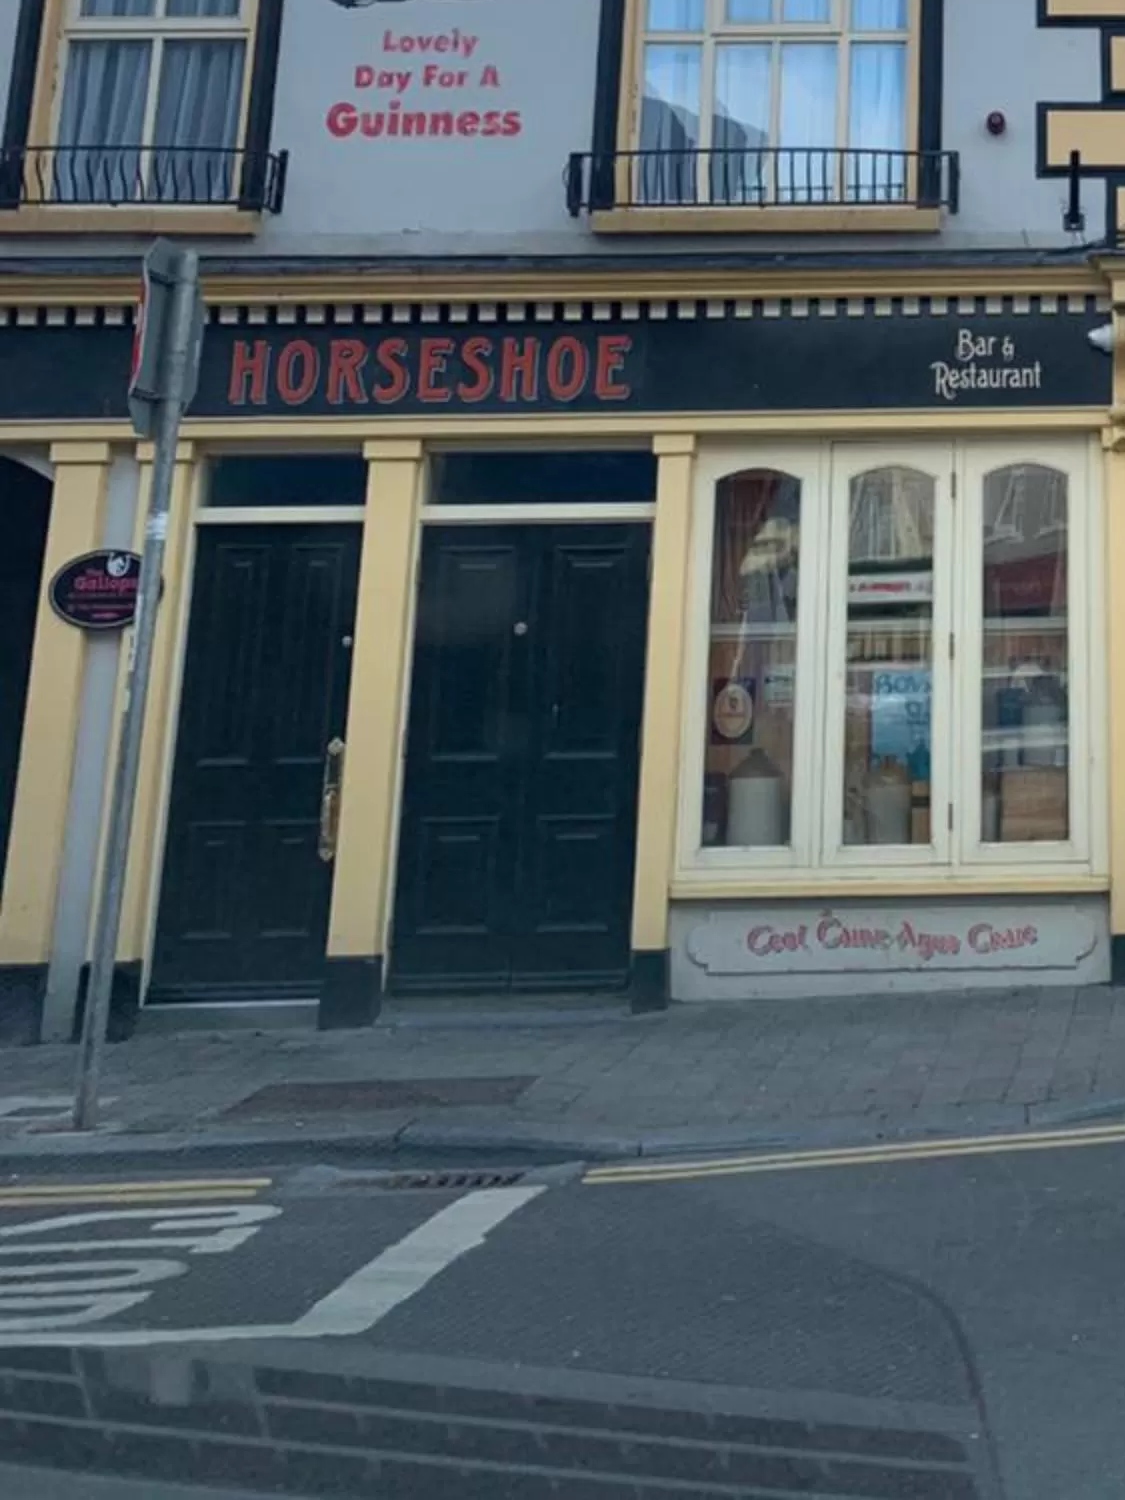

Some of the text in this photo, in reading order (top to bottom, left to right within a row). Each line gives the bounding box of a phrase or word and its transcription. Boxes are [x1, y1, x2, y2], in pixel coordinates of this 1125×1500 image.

[382, 27, 479, 58] Lovely
[354, 65, 500, 94] Day For A
[326, 99, 523, 139] Guinness
[955, 328, 997, 361] Bar
[227, 335, 632, 405] HORSESHOE
[929, 360, 1042, 400] Restaurant
